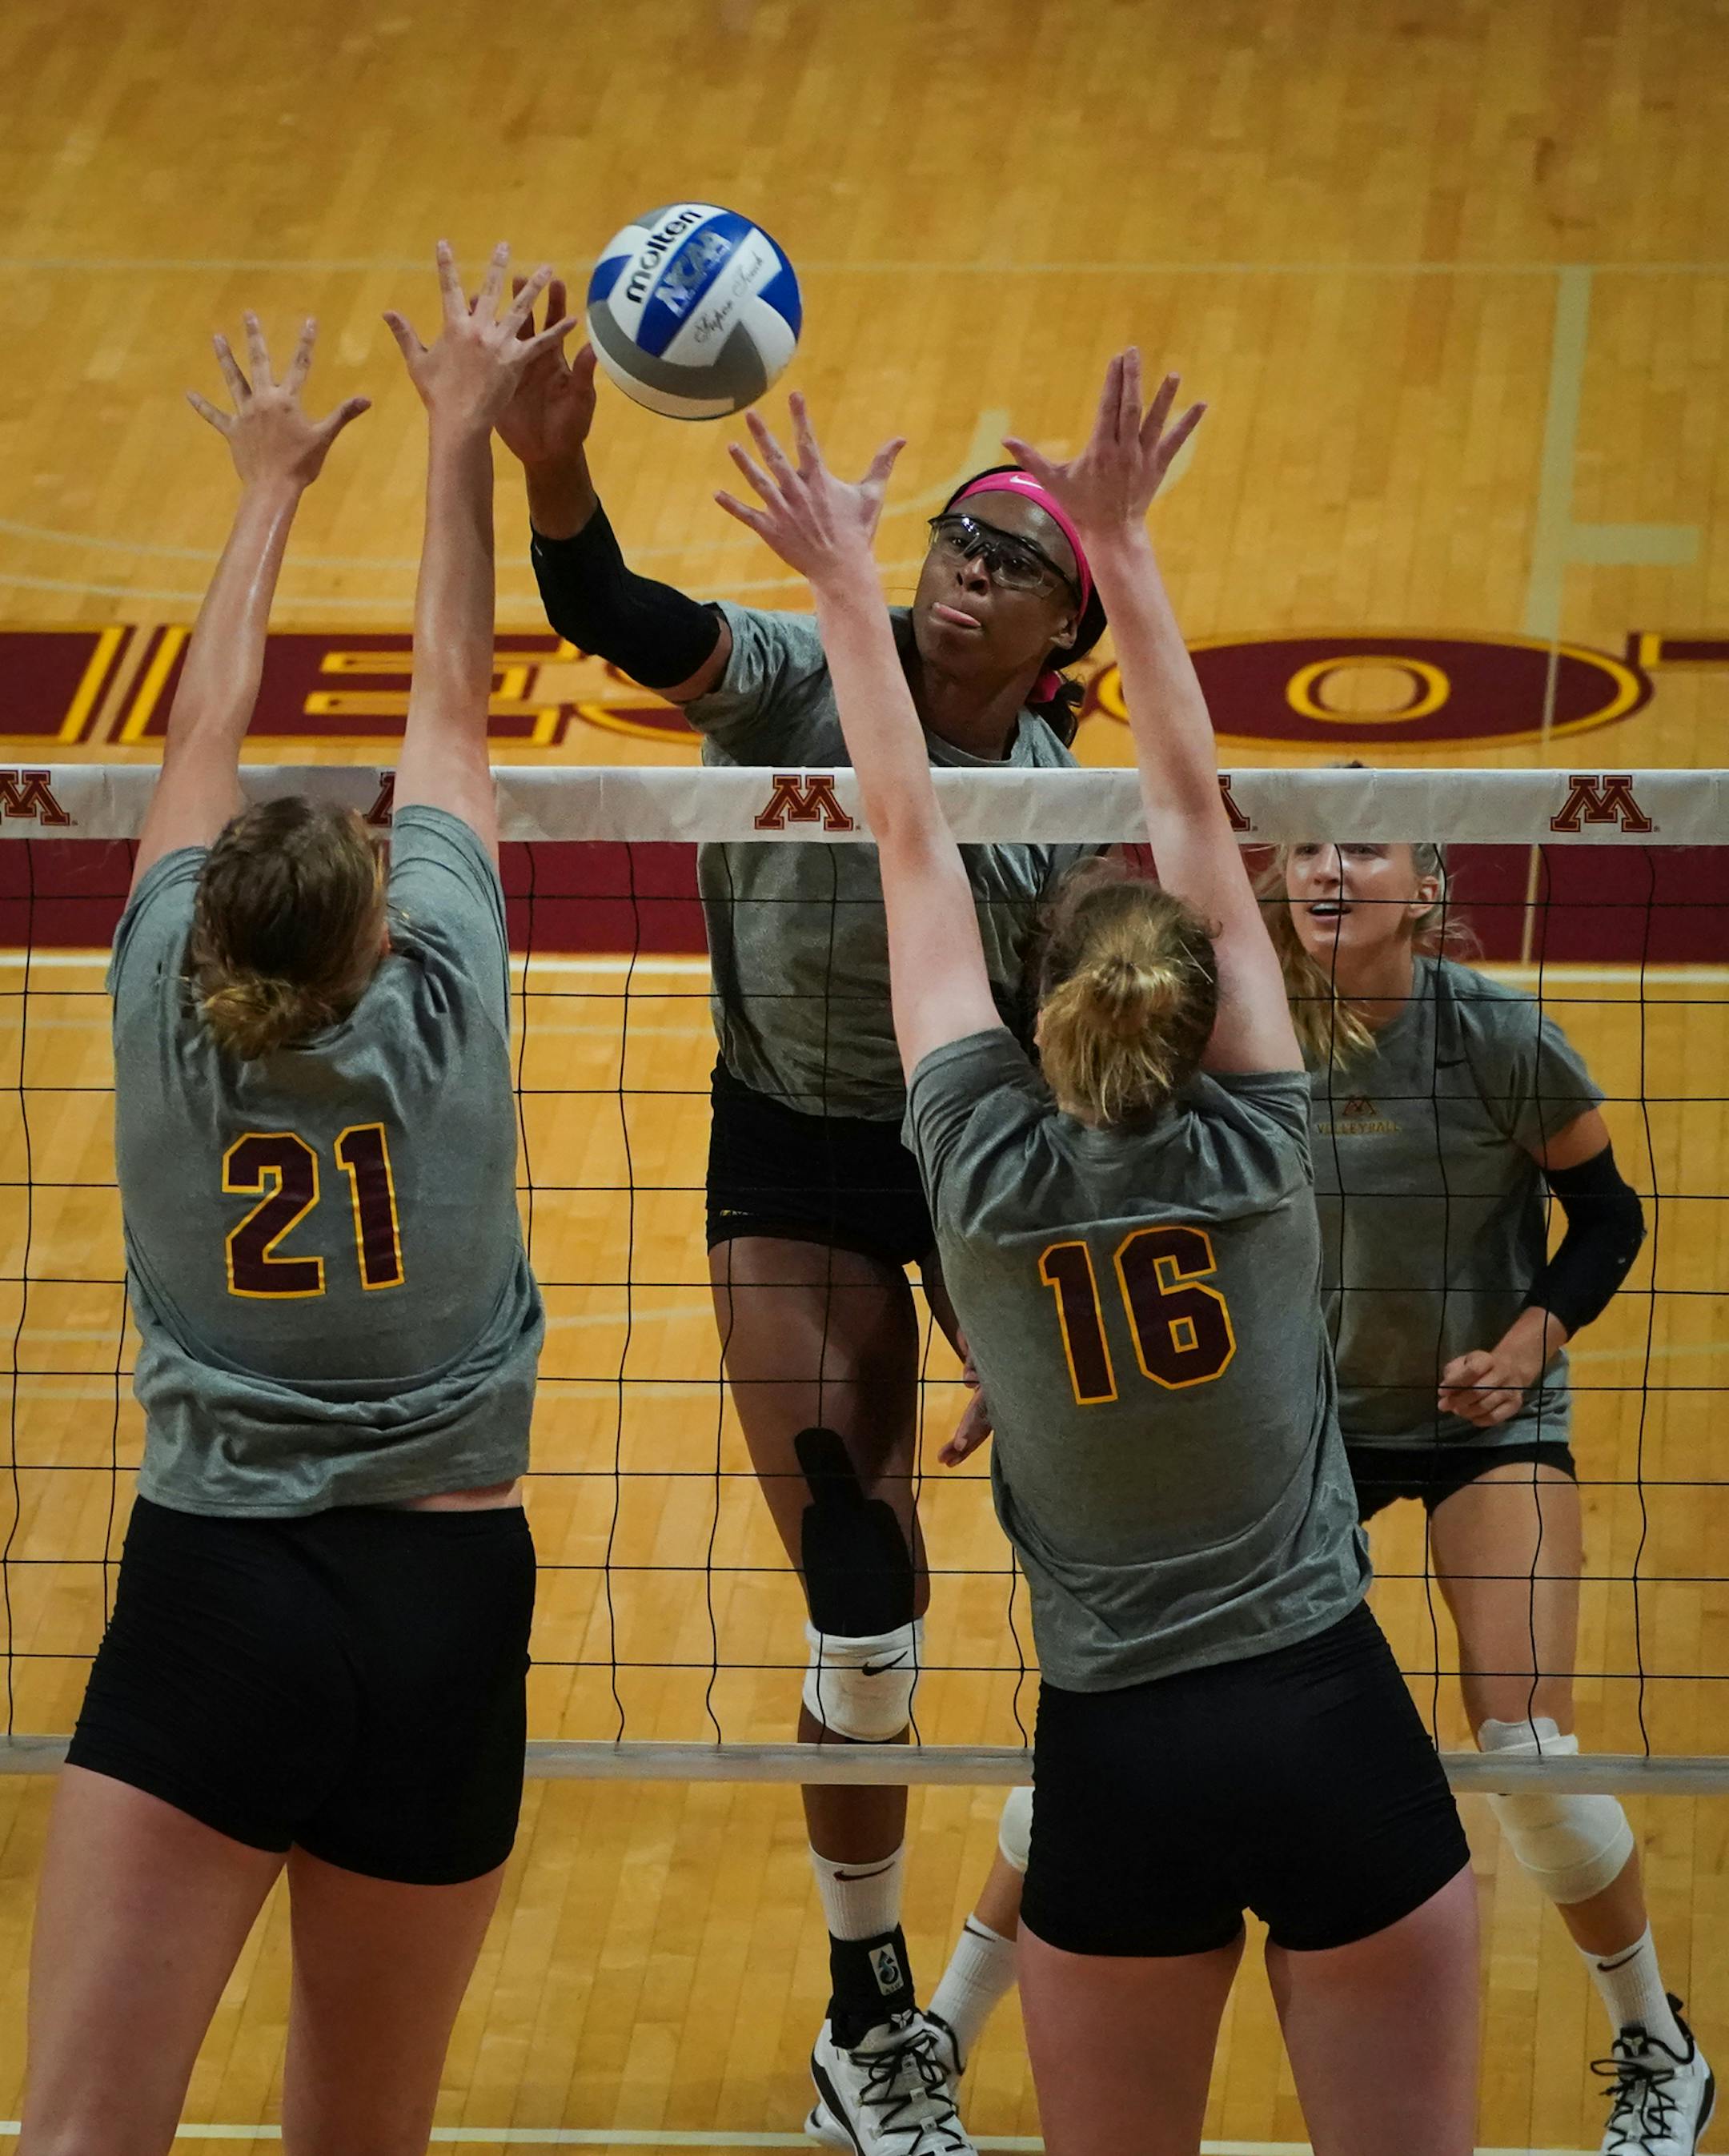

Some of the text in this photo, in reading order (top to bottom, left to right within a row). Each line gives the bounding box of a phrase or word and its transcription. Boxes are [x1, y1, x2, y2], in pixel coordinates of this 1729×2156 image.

[625, 208, 703, 304] molten
[654, 230, 734, 319] NCAA
[754, 774, 853, 831] M
[1550, 775, 1652, 832] M
[222, 1122, 405, 1299] 21
[1038, 1226, 1237, 1405] 16
